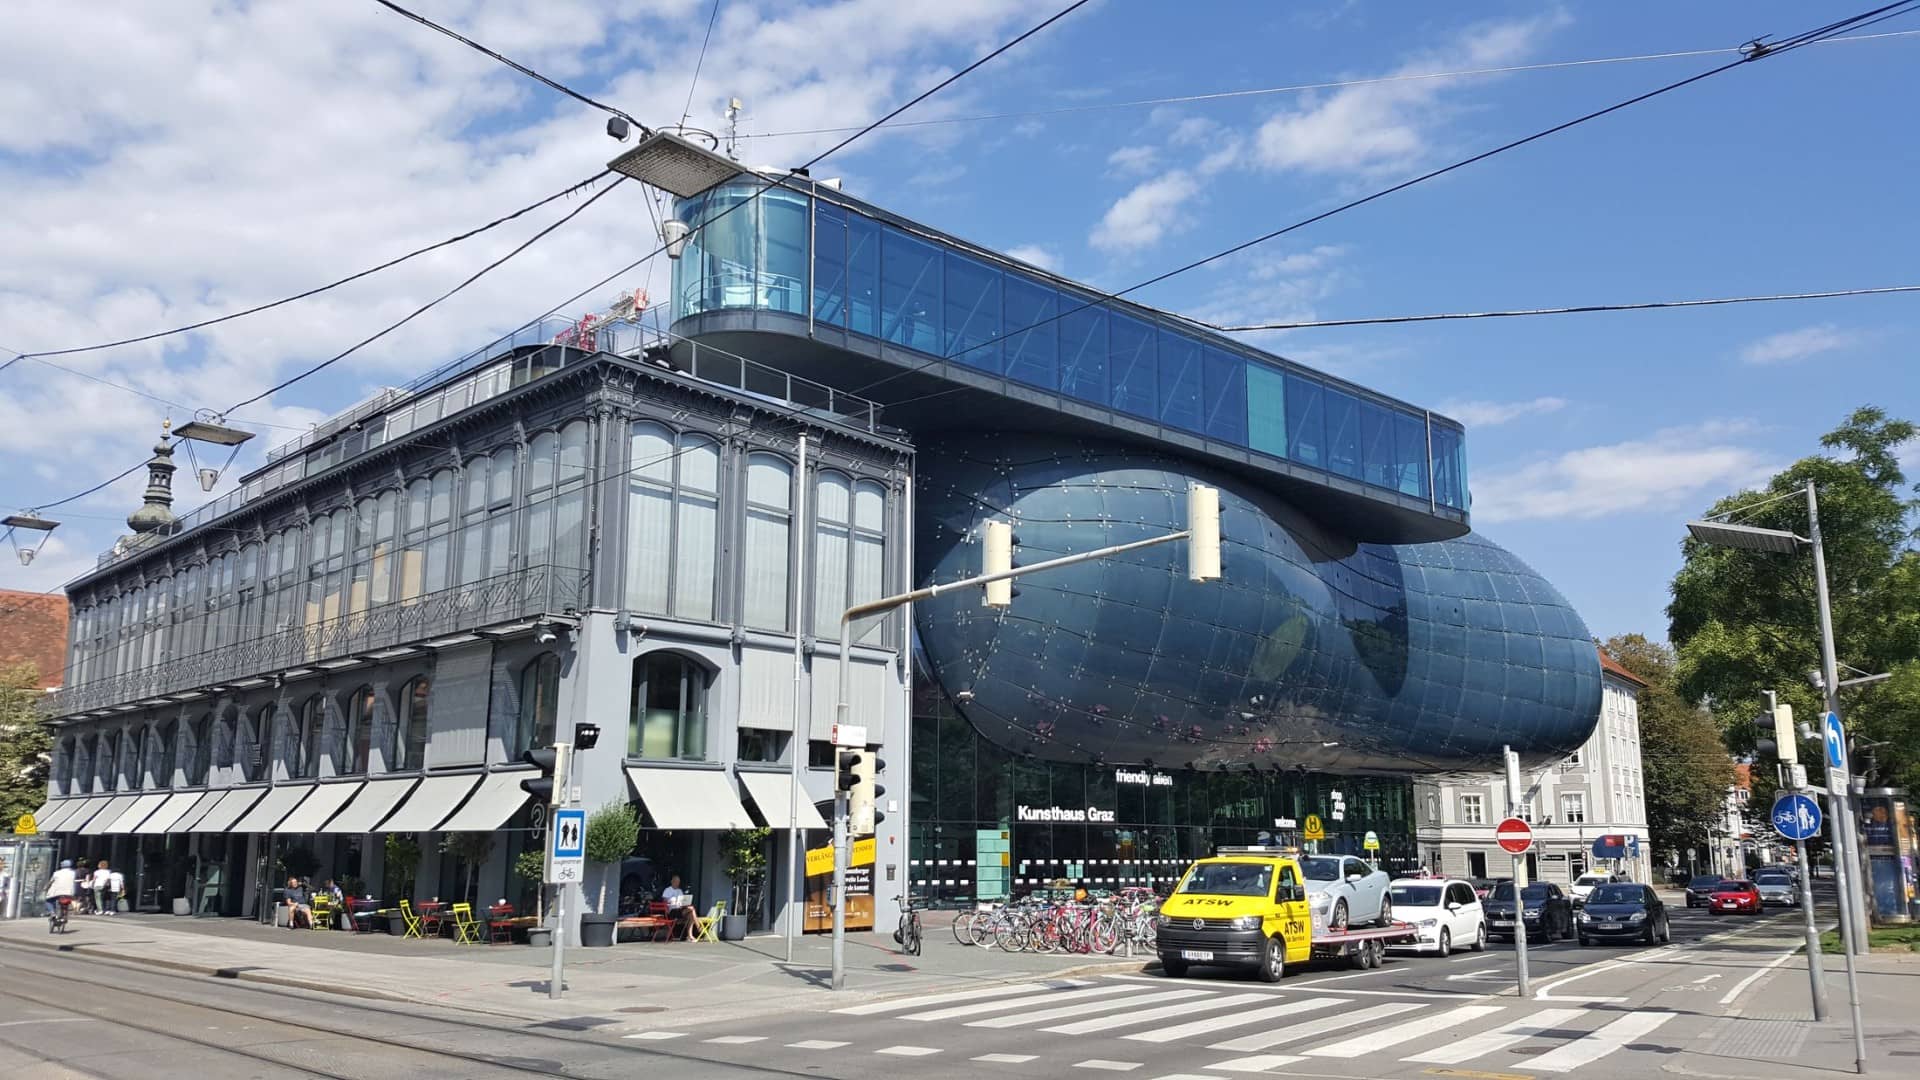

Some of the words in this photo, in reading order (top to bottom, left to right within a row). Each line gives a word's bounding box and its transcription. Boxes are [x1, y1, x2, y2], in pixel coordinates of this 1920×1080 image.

[1116, 769, 1150, 786] friendly
[1153, 772, 1172, 785] alien
[1018, 805, 1085, 821] Kunsthaus
[1088, 807, 1115, 821] Graz
[1309, 817, 1318, 830] H
[1285, 920, 1305, 935] ATSW
